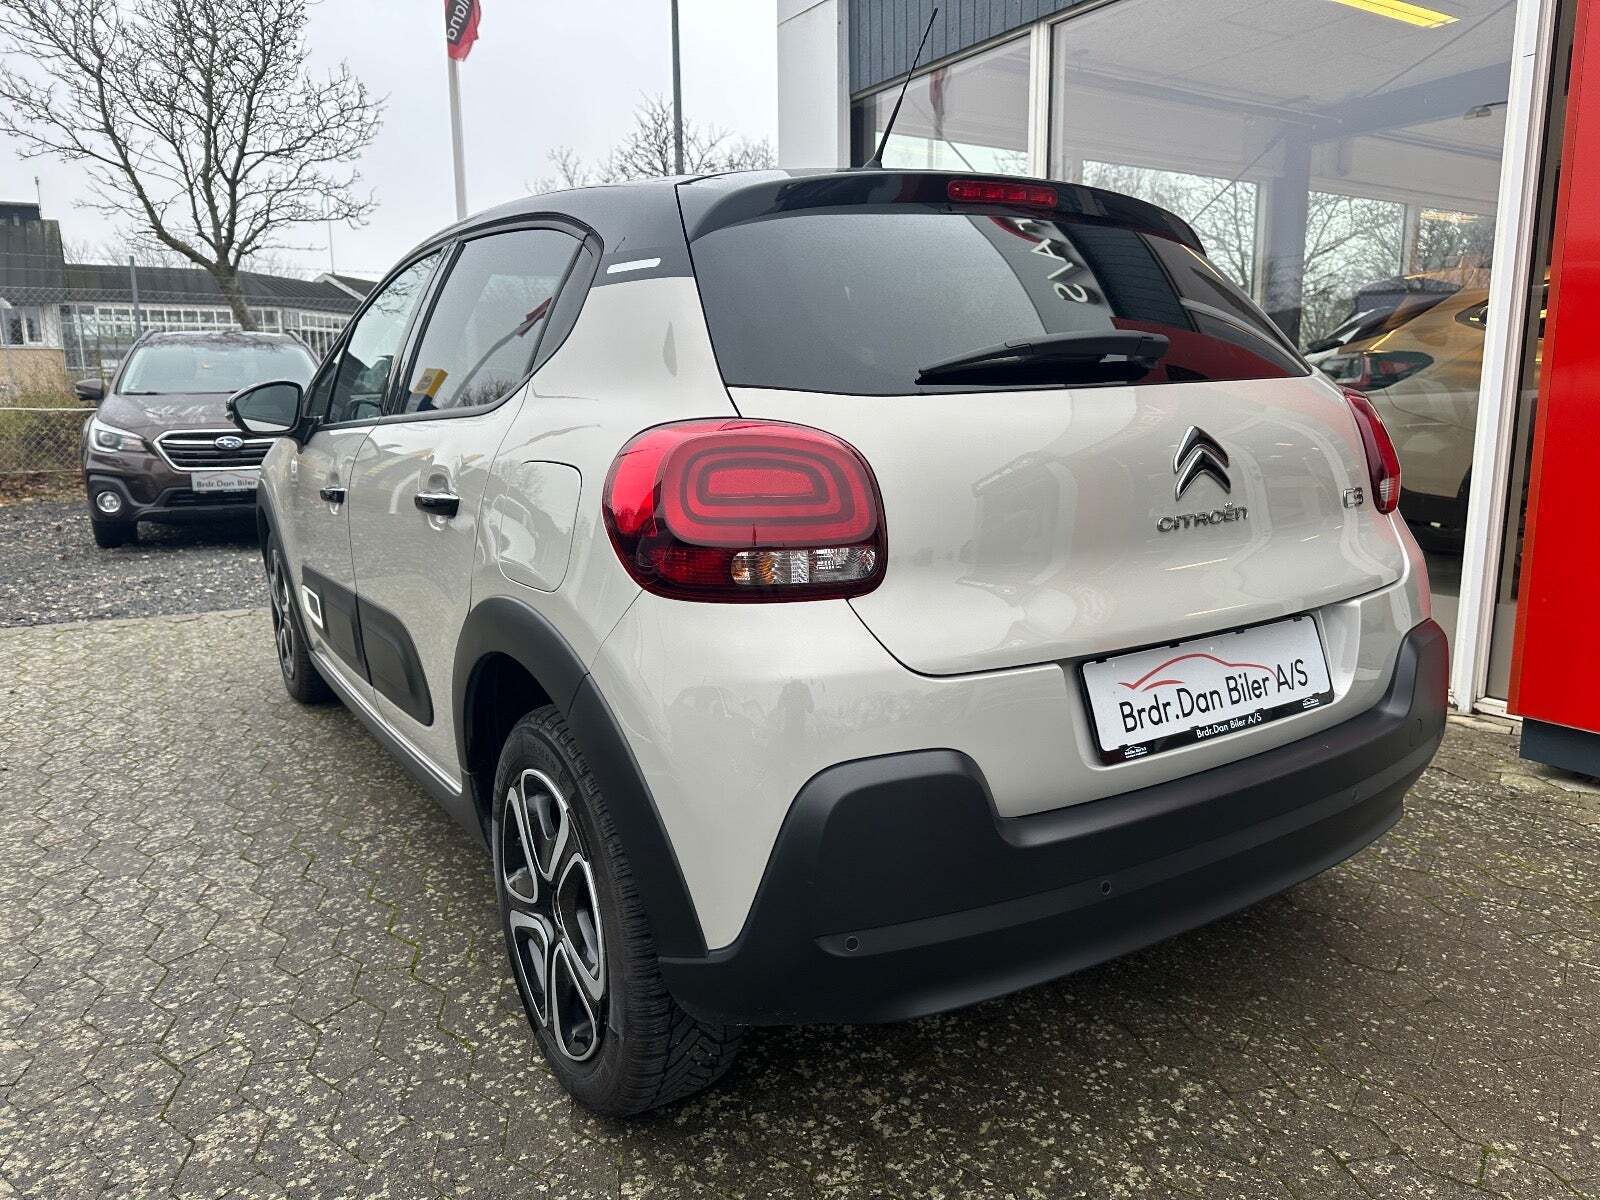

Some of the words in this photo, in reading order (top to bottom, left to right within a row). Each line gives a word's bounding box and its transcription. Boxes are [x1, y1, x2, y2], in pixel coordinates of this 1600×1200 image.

[1343, 487, 1363, 508] C3
[1119, 688, 1223, 732] Brdr.Dan
[1225, 673, 1269, 705] Biler
[1276, 658, 1308, 693] A/S
[1196, 724, 1229, 738] Brdr.Dan
[1229, 717, 1246, 729] Biler
[1247, 712, 1262, 725] A/S
